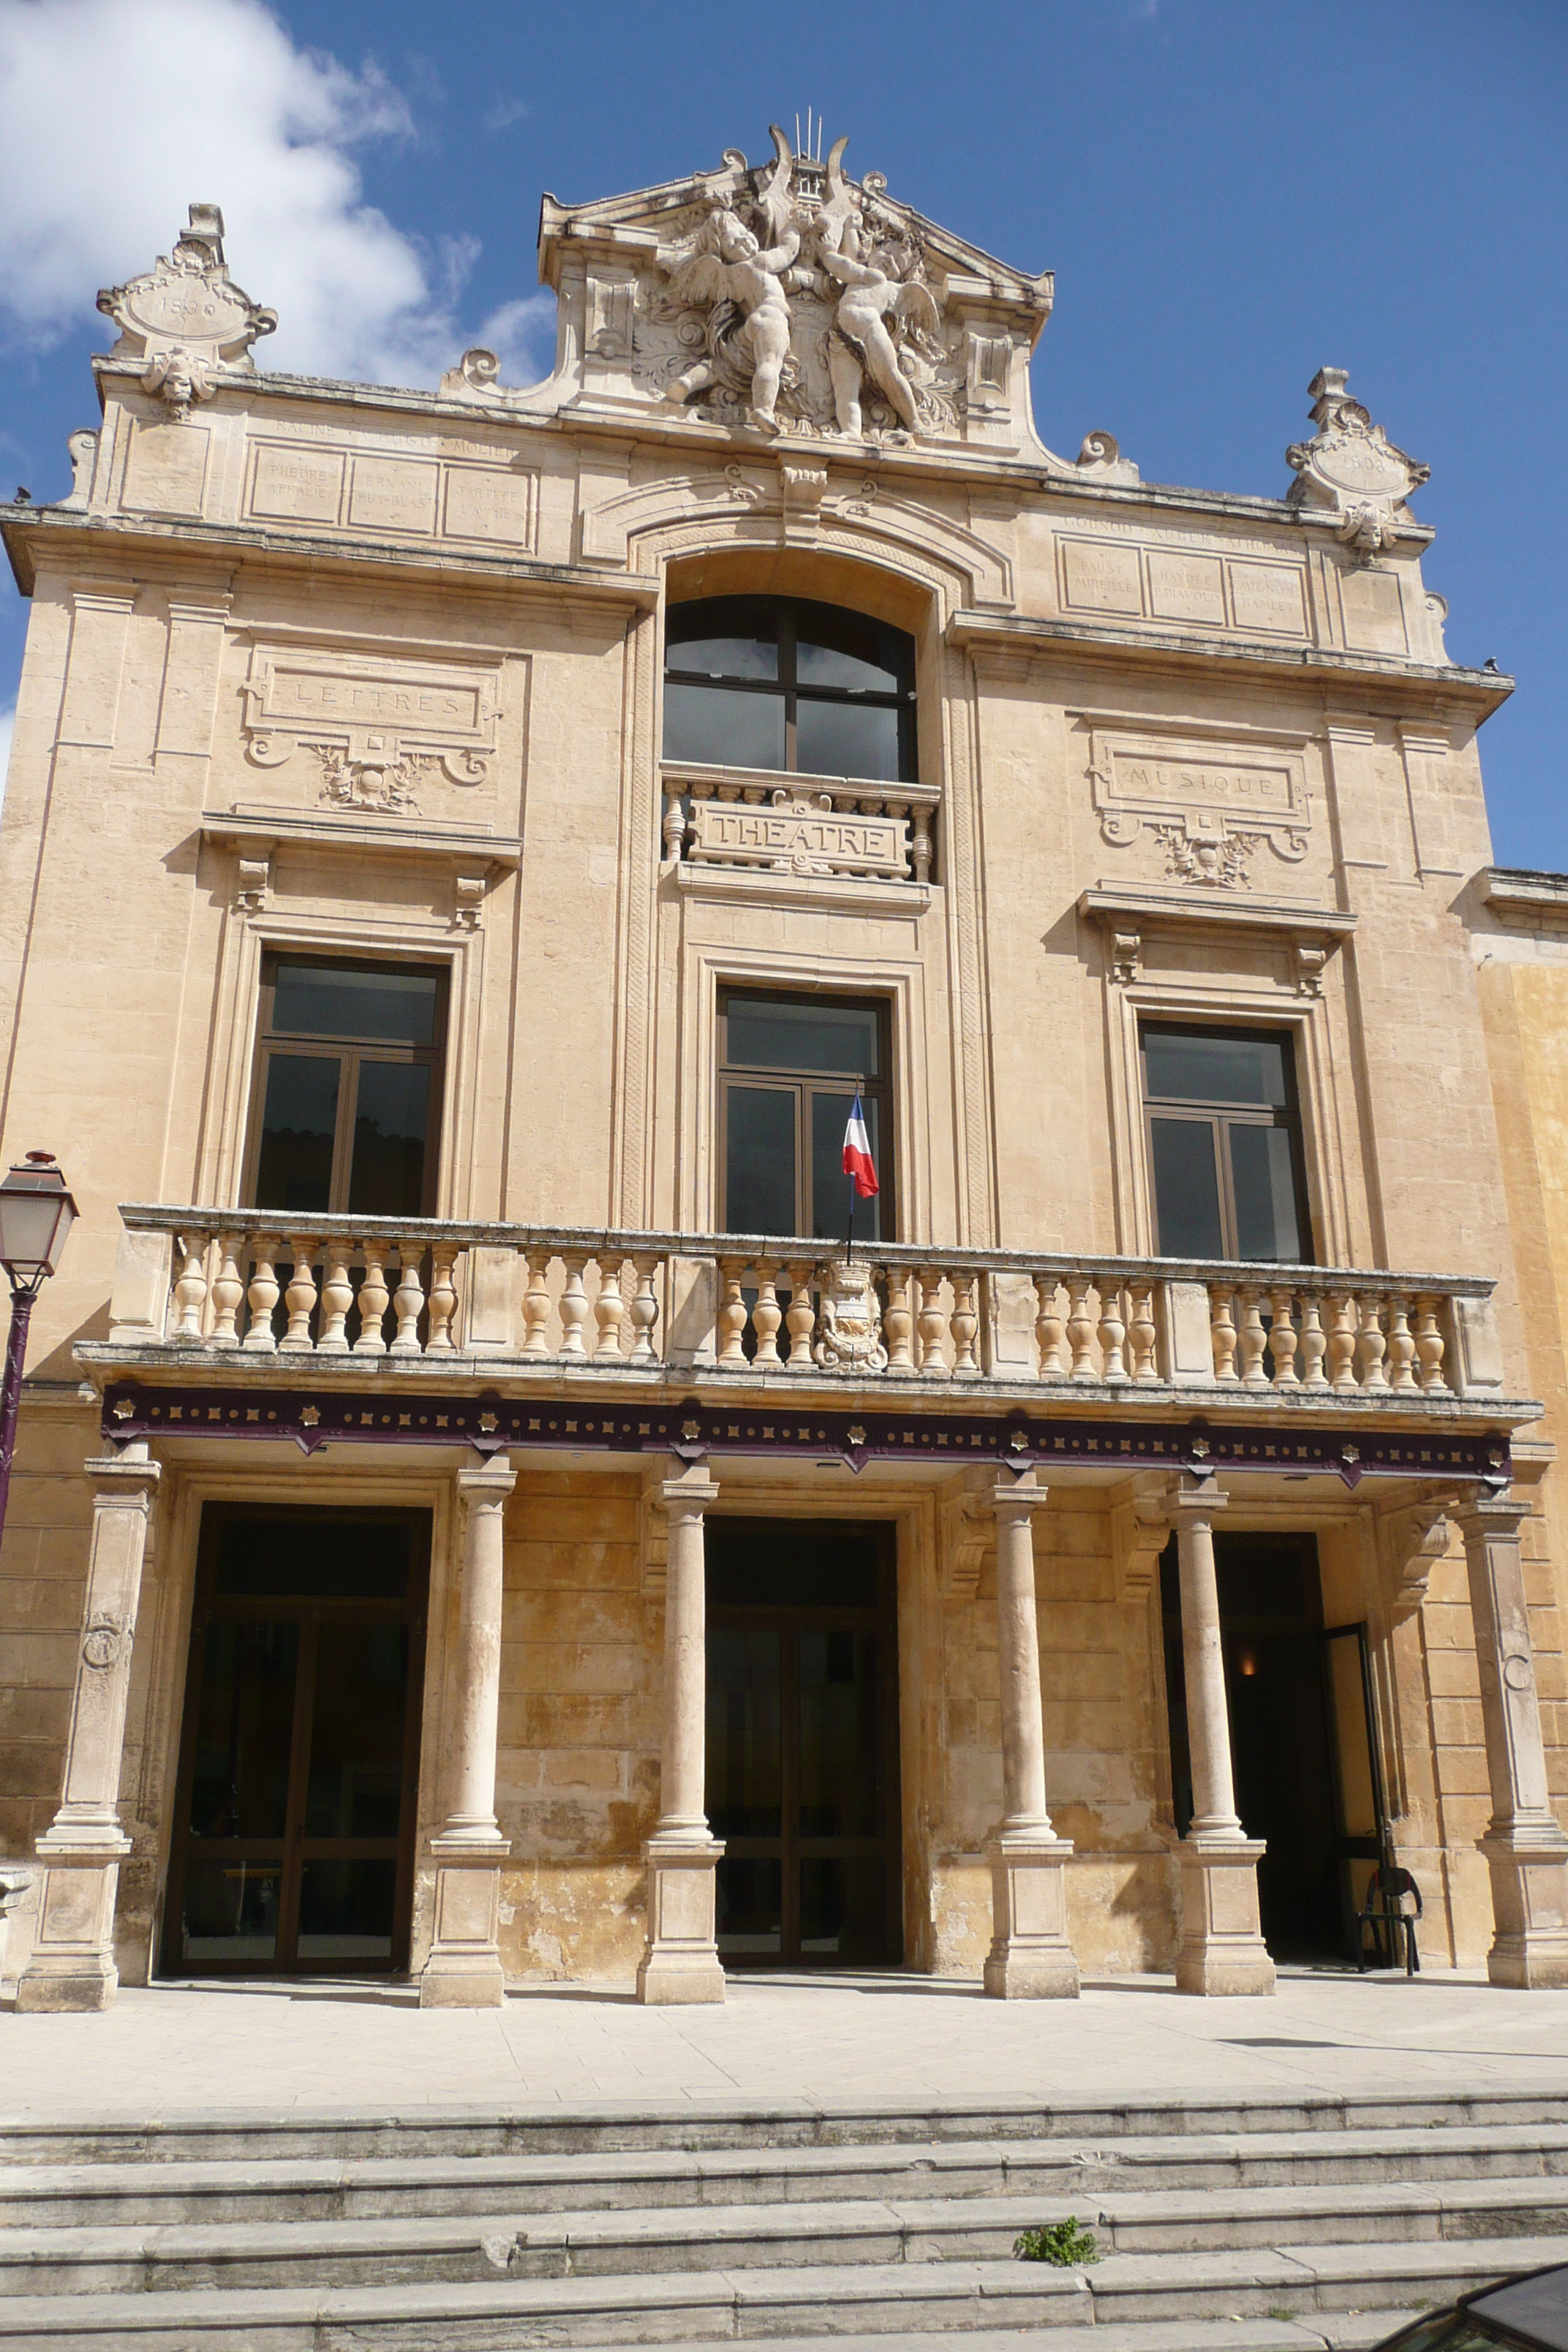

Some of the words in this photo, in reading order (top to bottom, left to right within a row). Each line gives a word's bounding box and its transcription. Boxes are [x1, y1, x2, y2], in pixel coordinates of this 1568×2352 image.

[1064, 516, 1133, 533] GOUNOD
[1082, 560, 1122, 574] FAUST
[1075, 576, 1134, 593] MIREILLE
[1240, 580, 1294, 596] MIGNON
[1242, 597, 1294, 612] HAMLET
[296, 684, 459, 714] LETTRES
[1130, 768, 1275, 796] MUSIQUE
[712, 818, 887, 857] THEATRE
